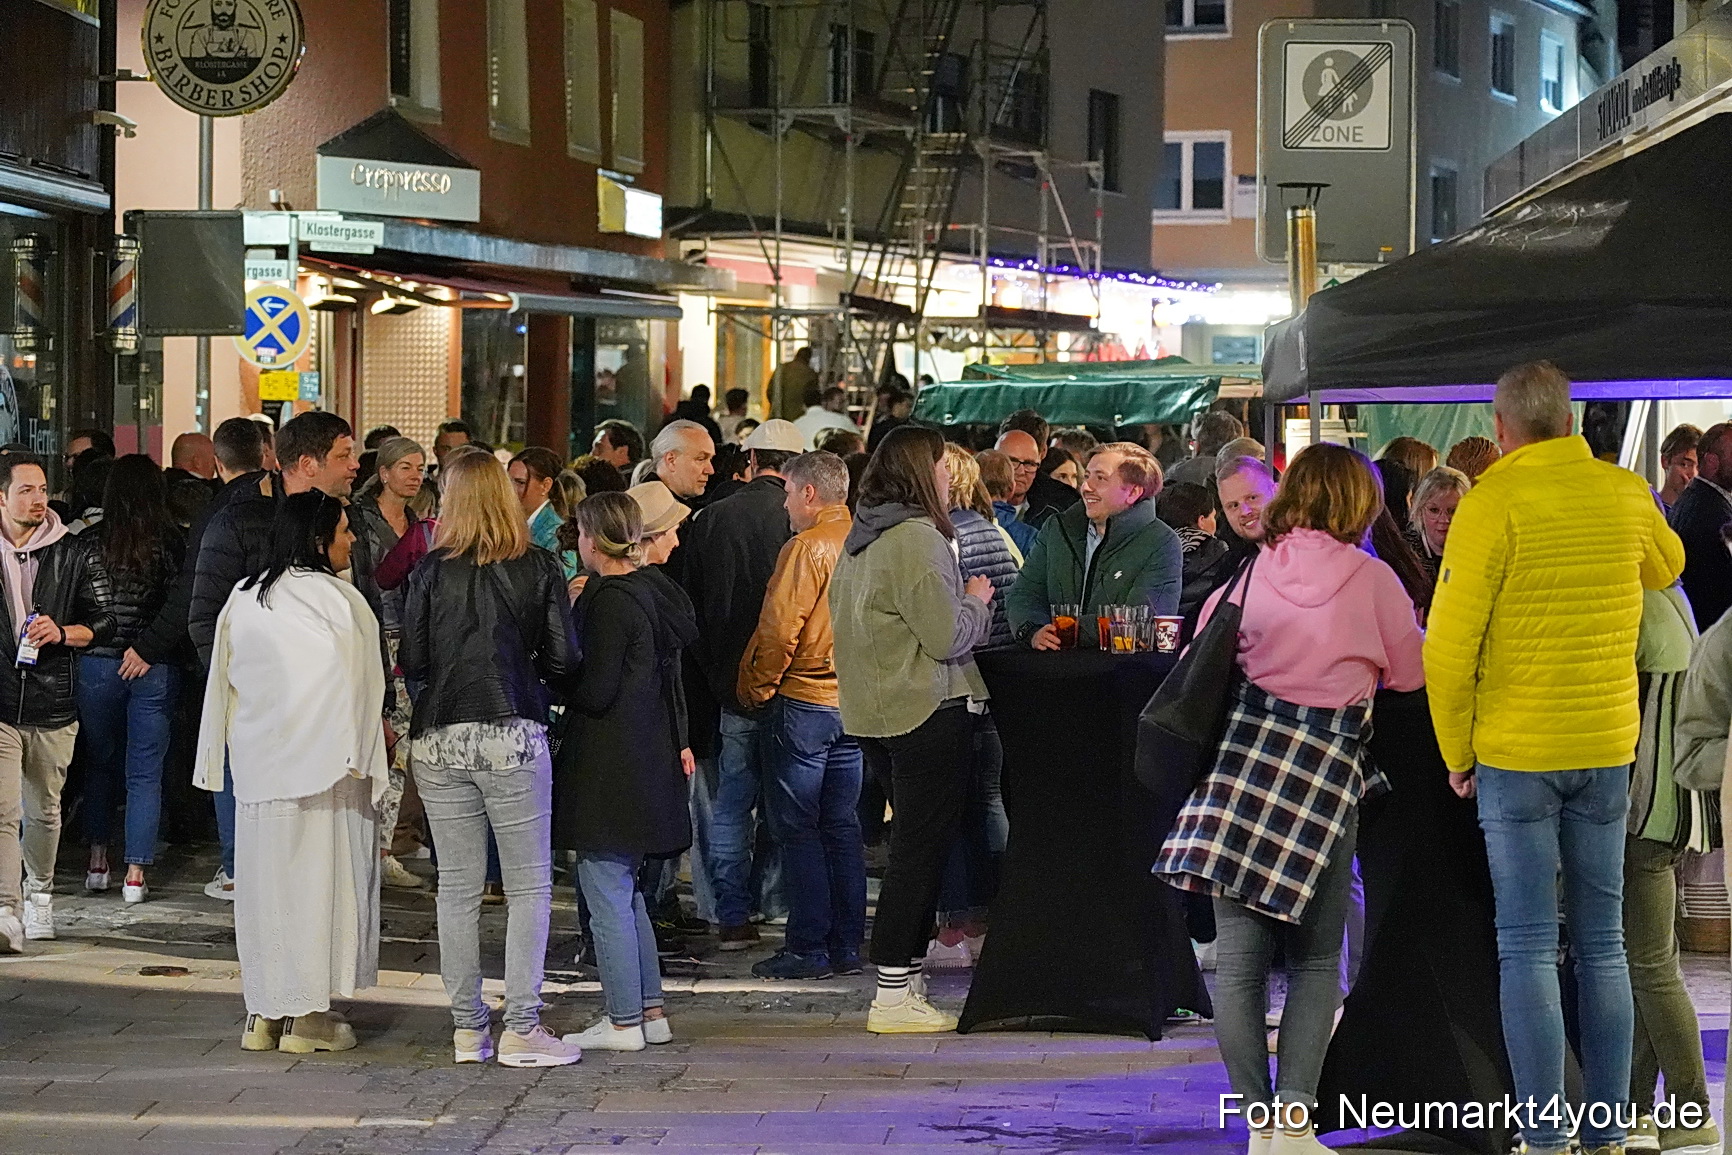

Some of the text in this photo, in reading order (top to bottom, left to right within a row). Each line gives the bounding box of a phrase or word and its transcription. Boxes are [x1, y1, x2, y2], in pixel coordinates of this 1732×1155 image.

[1310, 125, 1364, 143] ZONE
[306, 222, 375, 241] Klostergasse
[246, 265, 283, 281] rgasse
